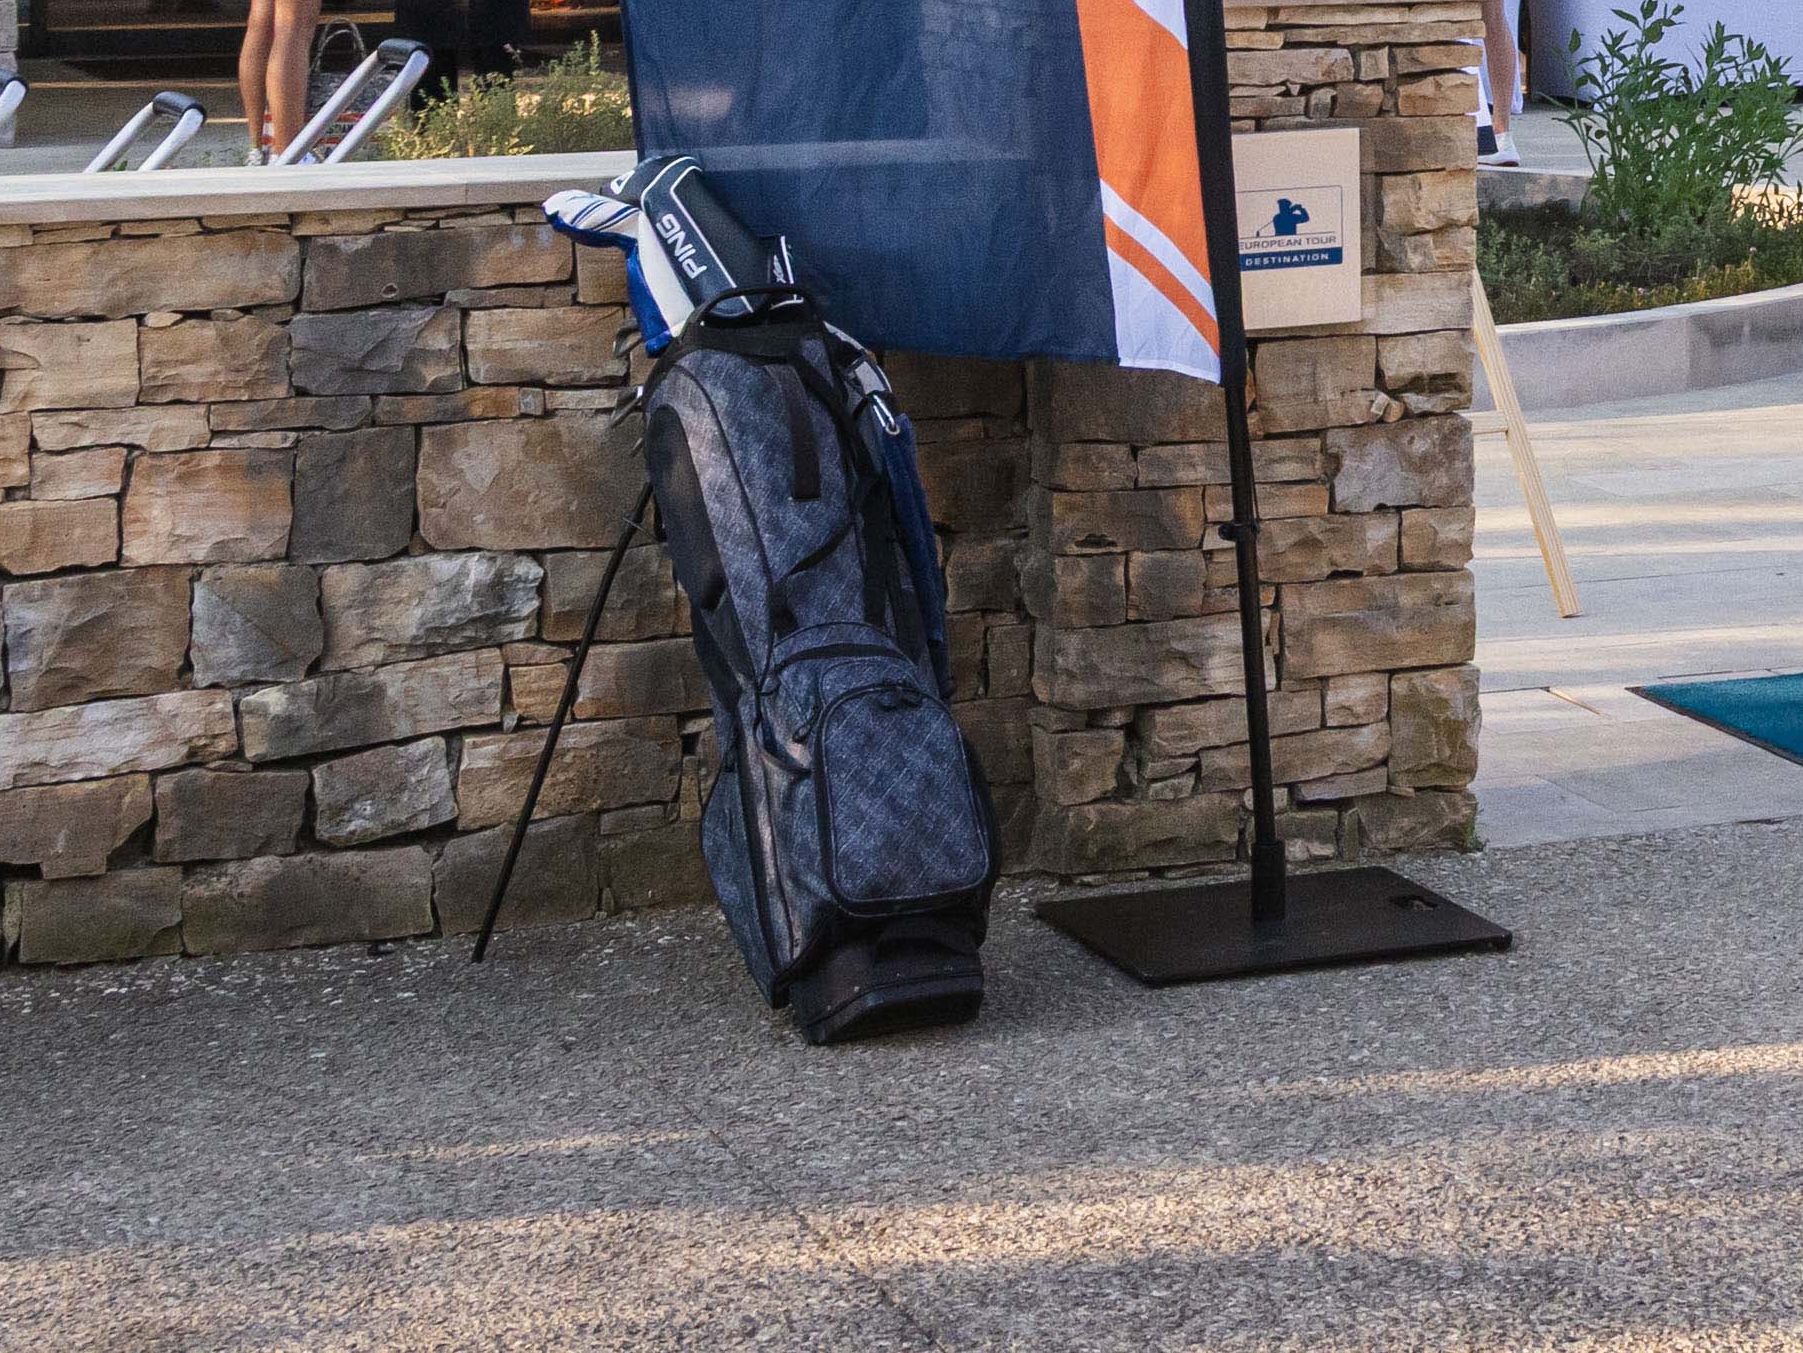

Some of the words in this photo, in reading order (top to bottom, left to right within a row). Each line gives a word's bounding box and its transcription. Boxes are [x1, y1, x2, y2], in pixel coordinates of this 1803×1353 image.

[655, 213, 708, 280] PING
[1238, 238, 1302, 250] EUROPEAN
[1306, 235, 1337, 245] TOUR
[1245, 253, 1329, 266] DESTINATION
